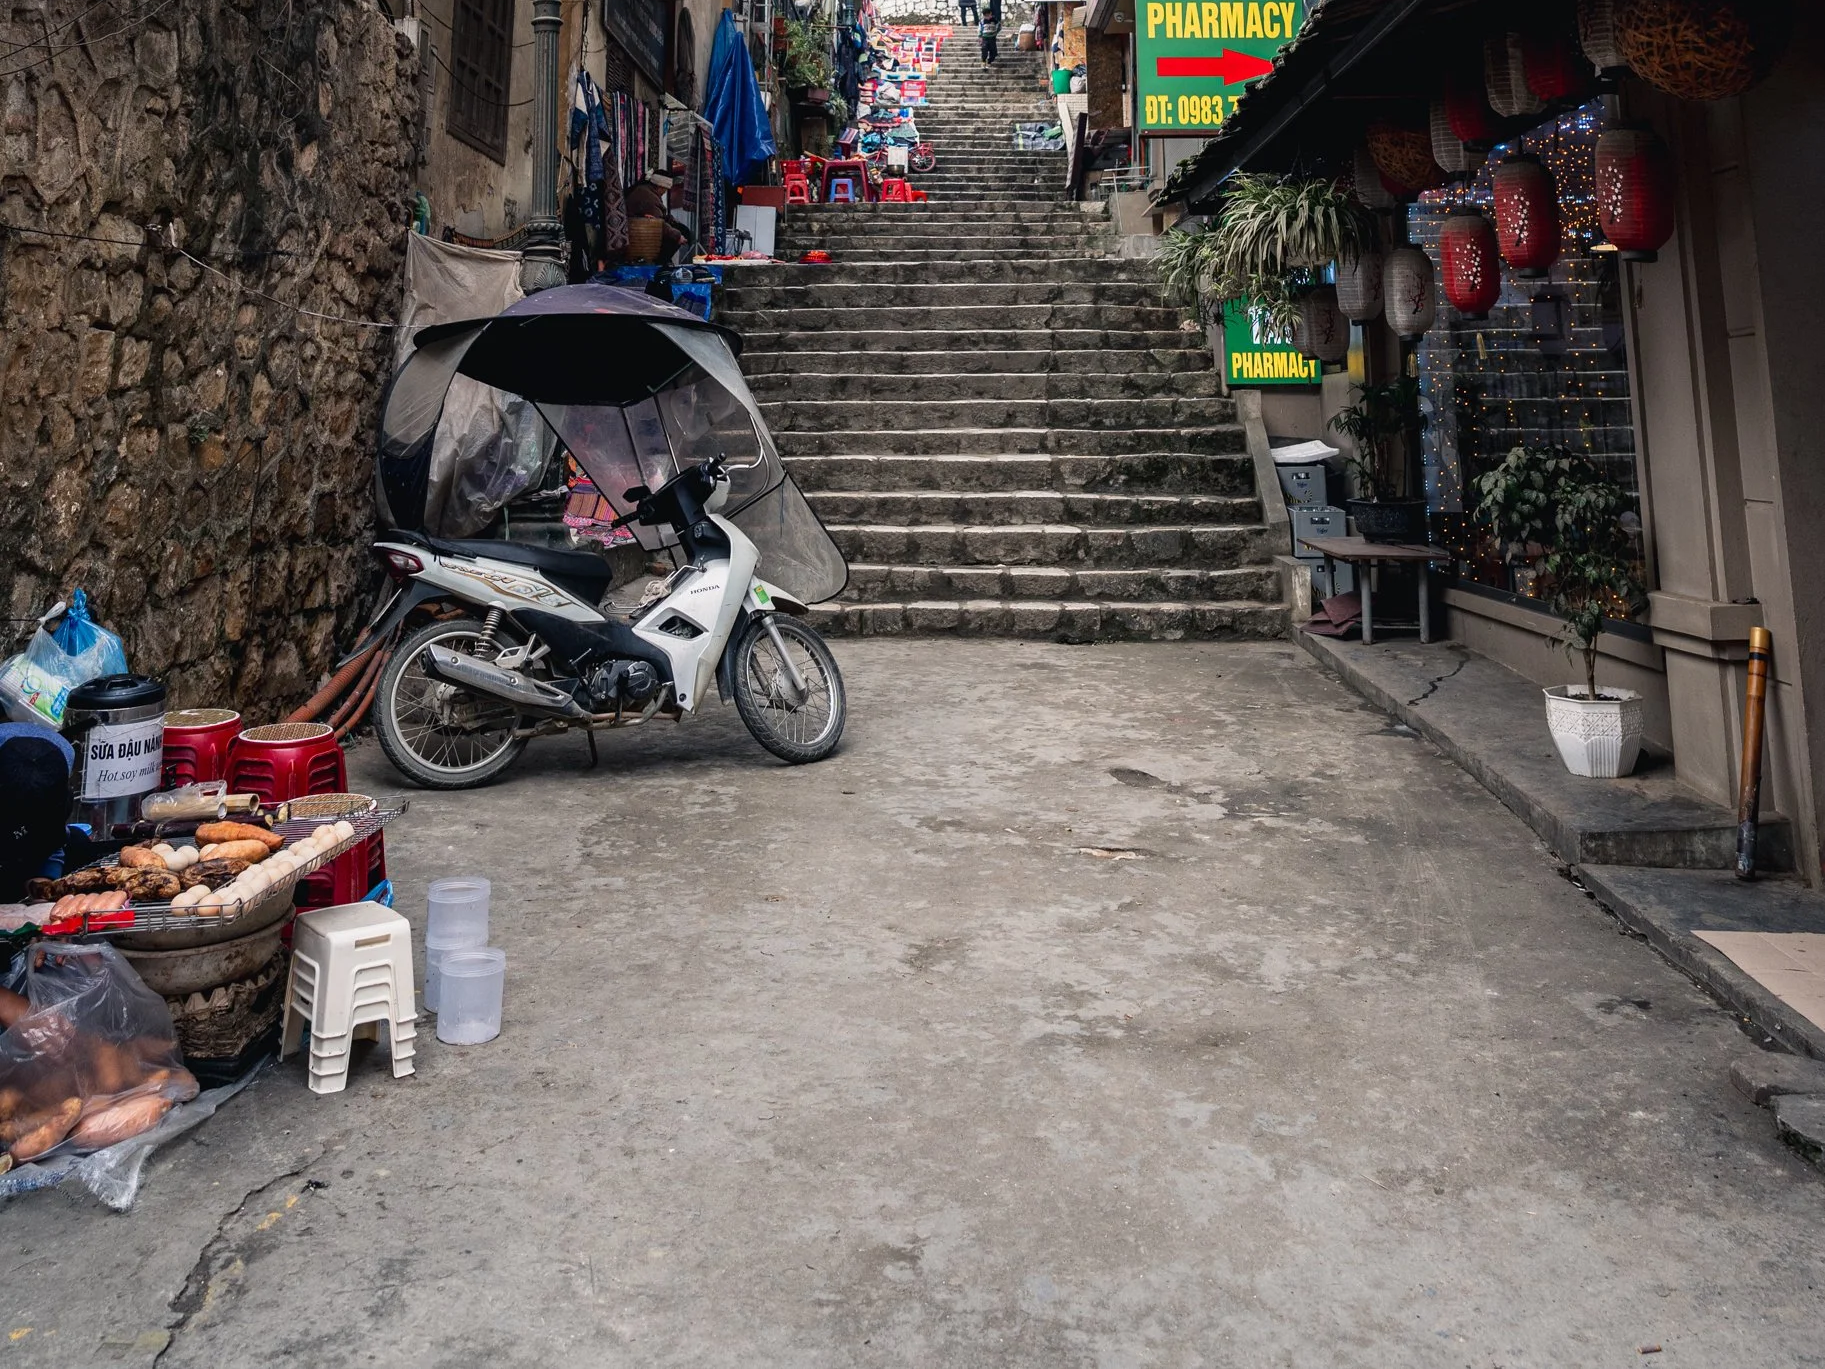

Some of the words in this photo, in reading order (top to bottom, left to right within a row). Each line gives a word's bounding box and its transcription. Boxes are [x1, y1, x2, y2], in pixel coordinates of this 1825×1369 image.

[1147, 2, 1295, 39] PHARMACY
[1145, 95, 1172, 124] ĐT:
[1178, 95, 1223, 124] 0983
[1231, 352, 1316, 378] PHARMACY
[690, 584, 720, 594] HONDA
[90, 741, 114, 760] SỮA
[118, 738, 141, 761] ĐẬU
[98, 769, 117, 782] Hot
[119, 768, 137, 782] soy
[139, 762, 155, 777] milk
